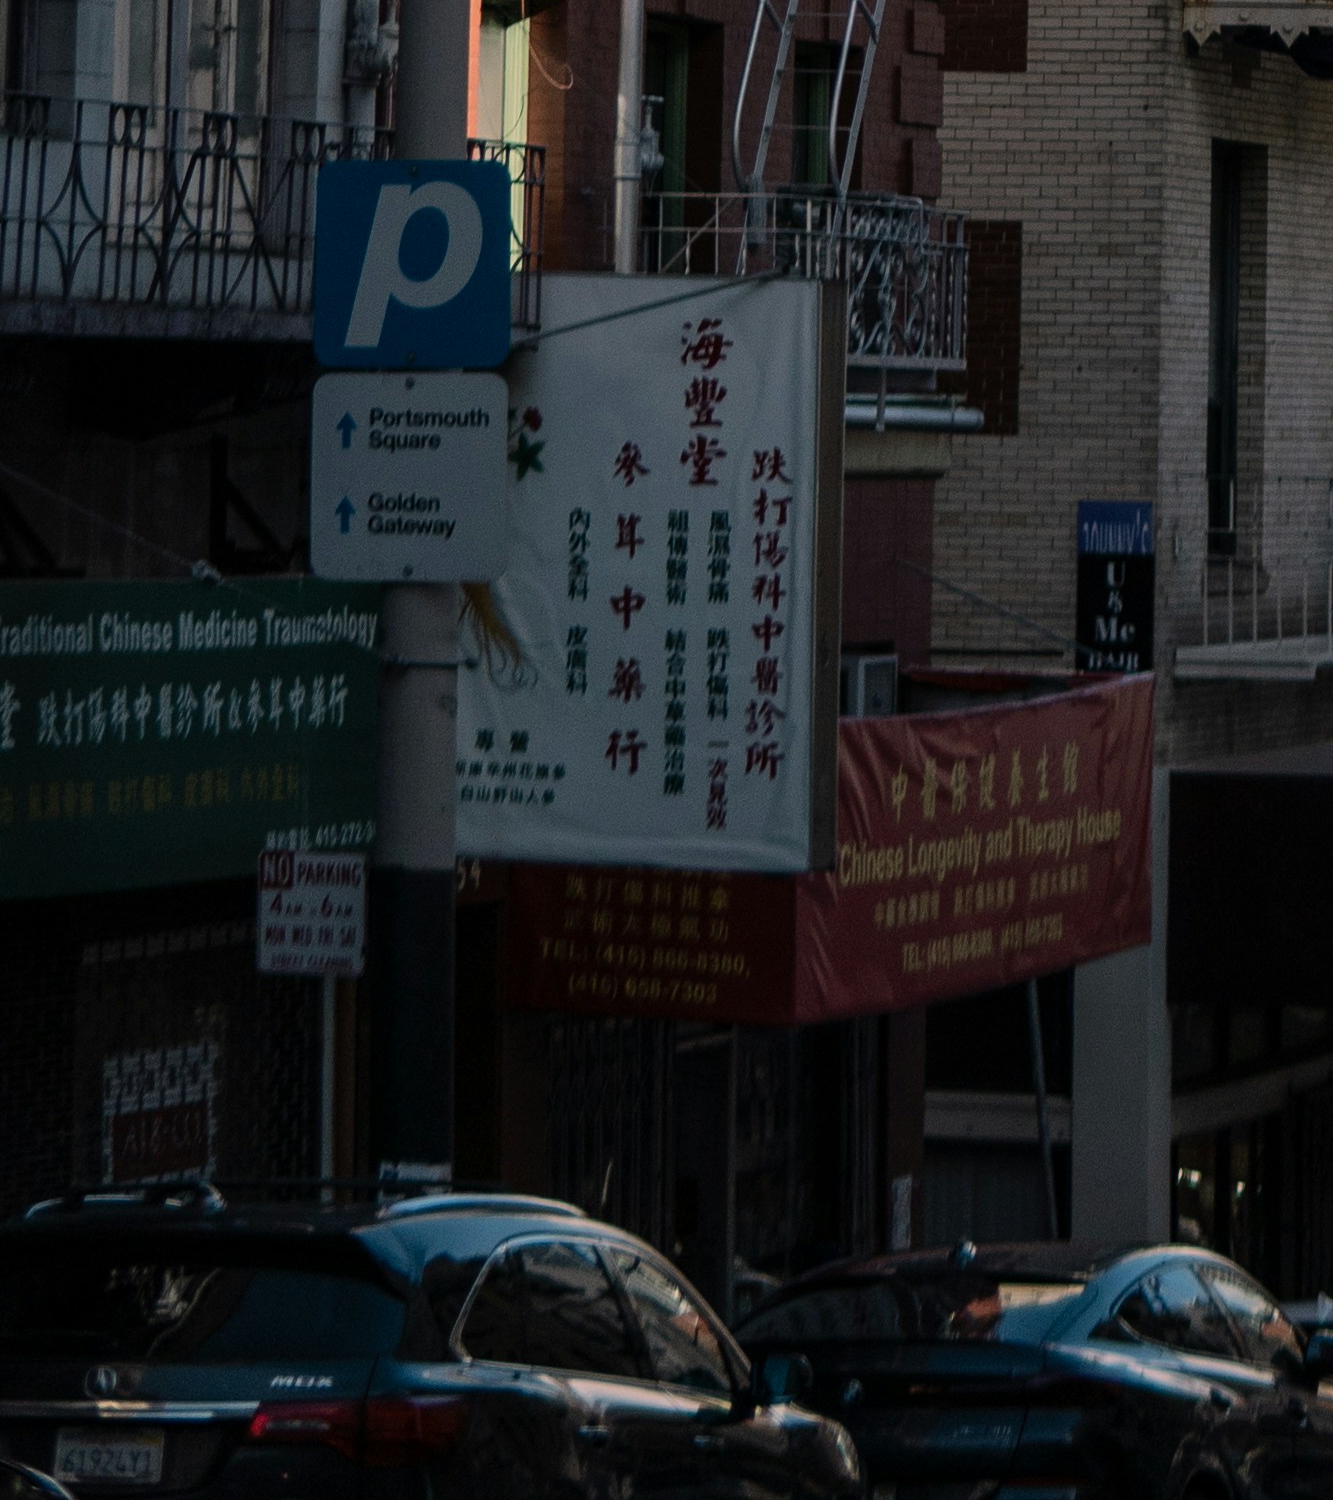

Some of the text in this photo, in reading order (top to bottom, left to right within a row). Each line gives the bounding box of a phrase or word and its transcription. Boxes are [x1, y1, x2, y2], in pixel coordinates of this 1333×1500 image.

[369, 407, 490, 429] Portsmouth
[368, 429, 441, 453] Square
[368, 493, 441, 514] Golden
[368, 514, 456, 539] Gateway
[0, 604, 378, 657] raditional Chinese Medicine Traumatology
[839, 805, 1122, 889] Chinese Longevity and Therapy House
[263, 852, 362, 887] NO PARKING
